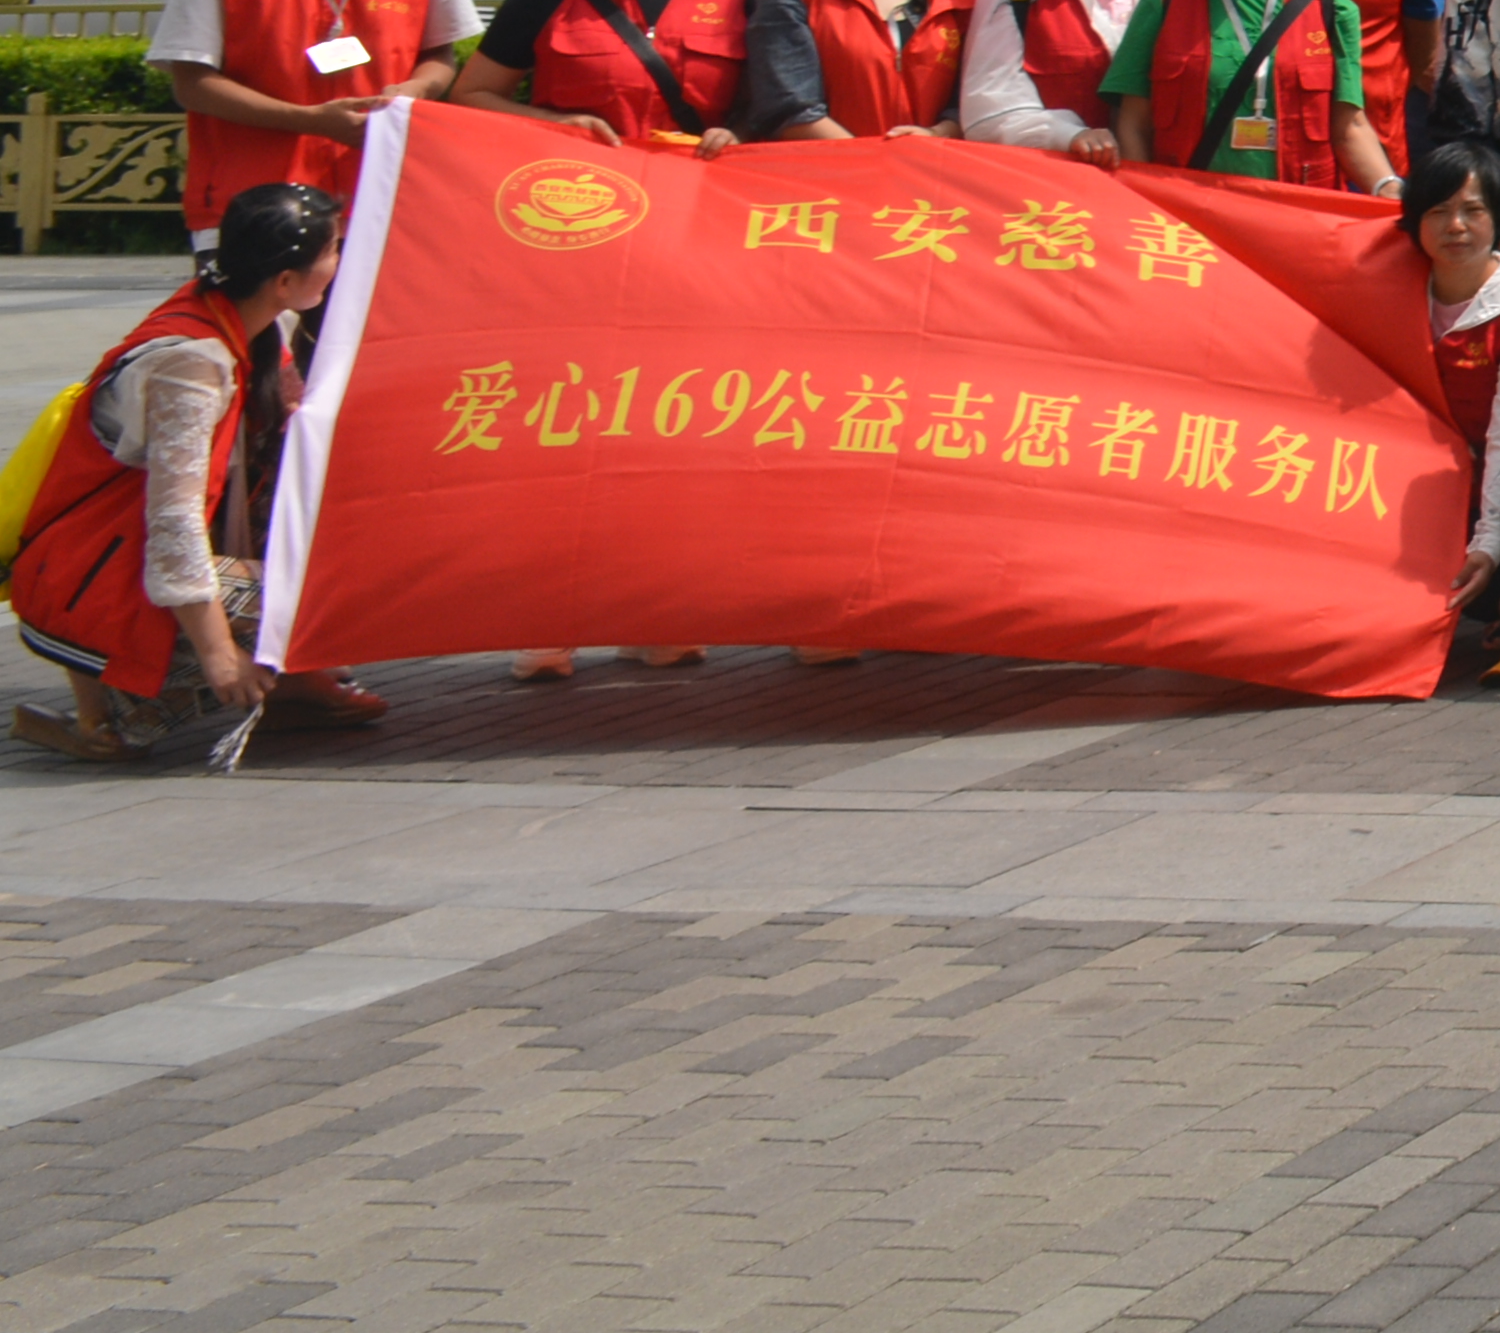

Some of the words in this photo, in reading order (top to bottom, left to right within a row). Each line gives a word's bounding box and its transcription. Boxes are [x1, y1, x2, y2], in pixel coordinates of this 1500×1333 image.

[743, 199, 1221, 288] 西安慈善
[434, 359, 1390, 521] 爱心169公益志愿者服务队
